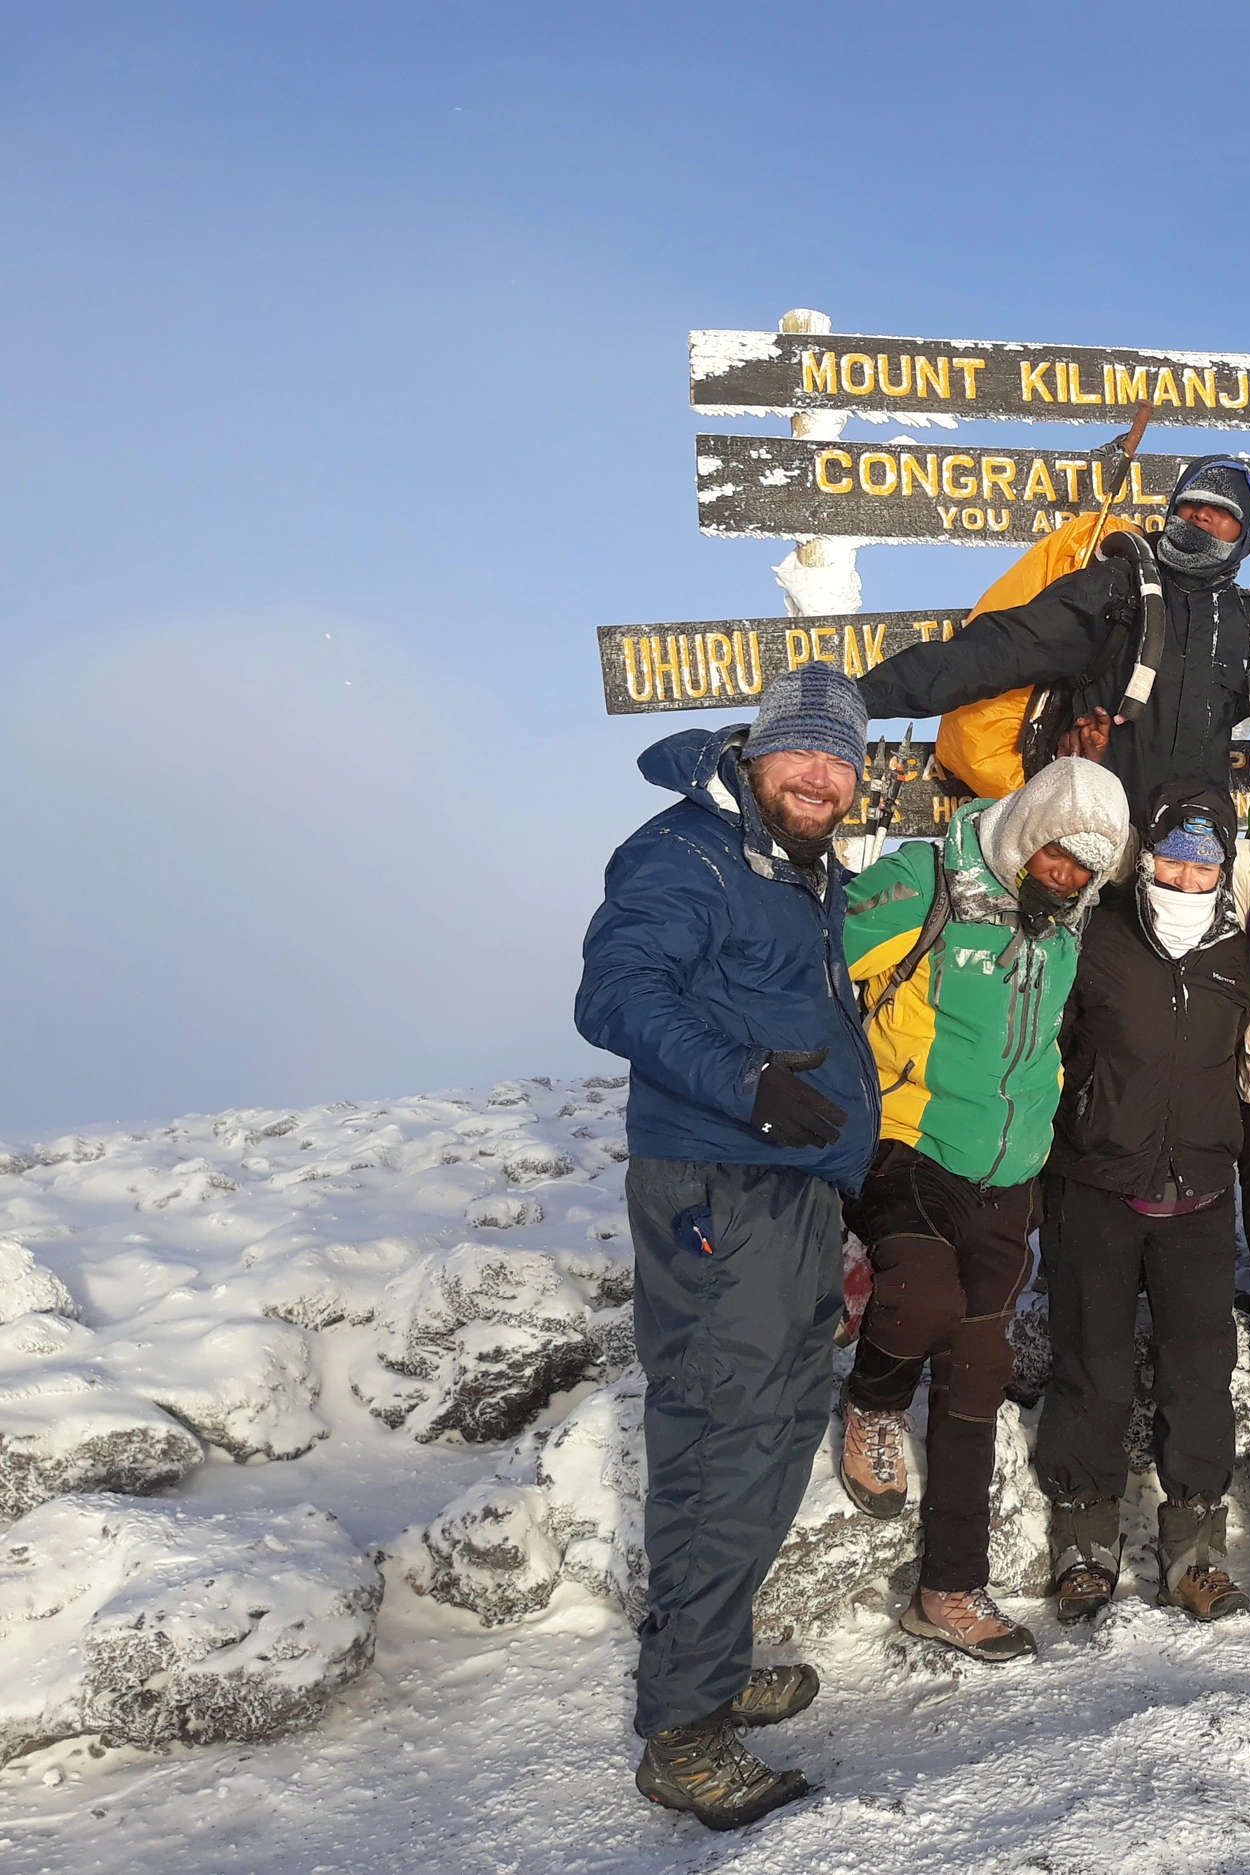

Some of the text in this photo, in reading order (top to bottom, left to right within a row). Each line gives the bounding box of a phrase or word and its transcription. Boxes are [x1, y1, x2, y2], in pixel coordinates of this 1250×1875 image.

[802, 351, 986, 400] MOUNT
[937, 506, 1011, 532] YOU
[623, 631, 762, 701] UHURU
